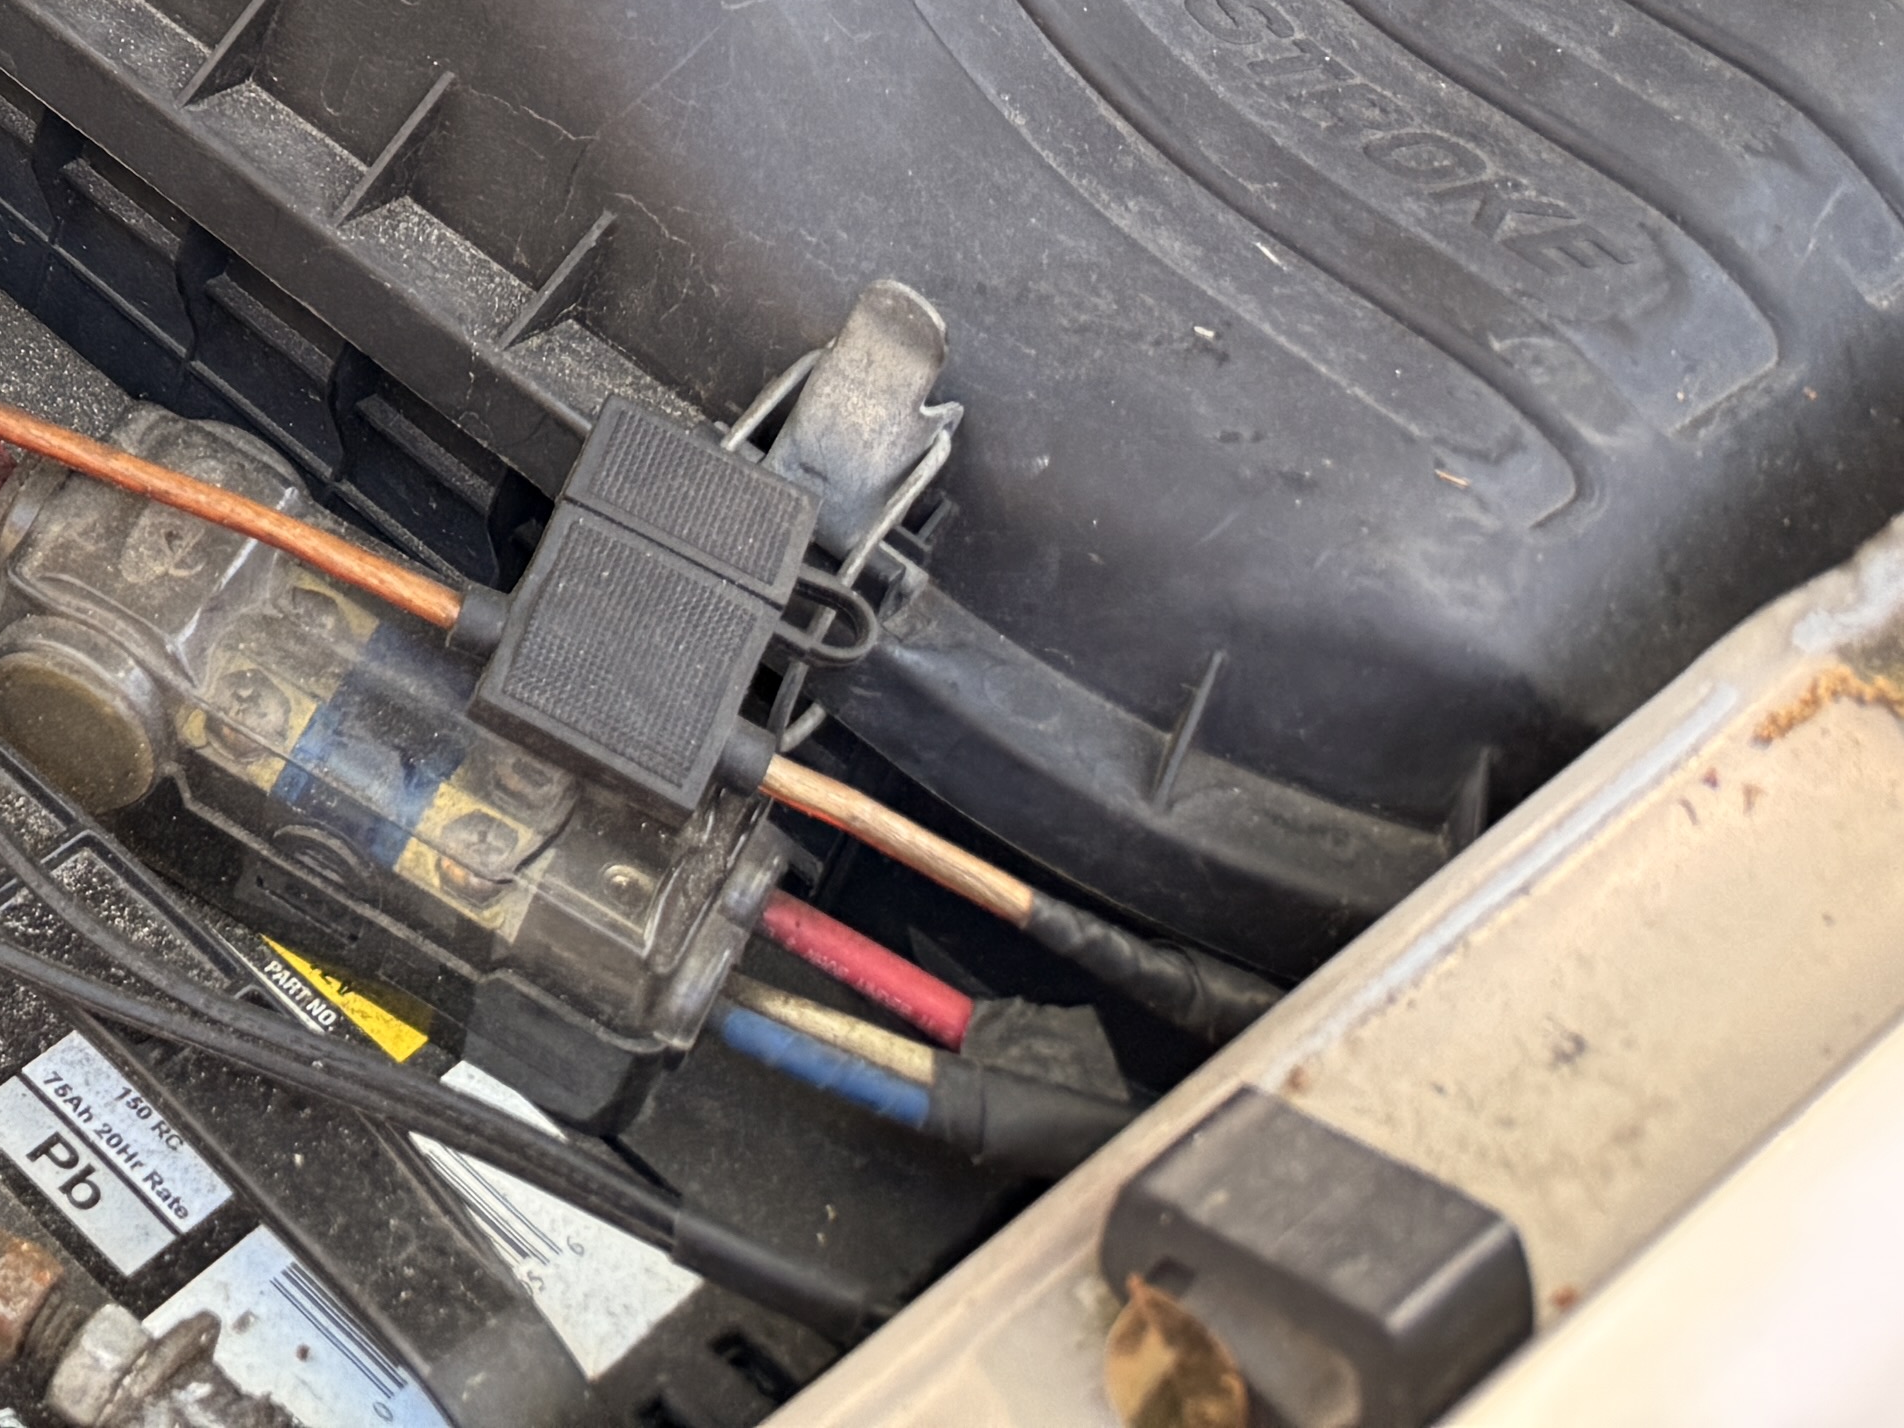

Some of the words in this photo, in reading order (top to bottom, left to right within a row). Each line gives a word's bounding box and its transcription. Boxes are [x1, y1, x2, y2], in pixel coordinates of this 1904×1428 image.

[264, 959, 306, 1008] PART
[305, 997, 339, 1033] NO.
[41, 1070, 96, 1125] 75Ah
[94, 1118, 146, 1170] 20Hr
[137, 1172, 190, 1220] Rate
[117, 1084, 154, 1123] 150
[147, 1120, 186, 1153] RC
[26, 1132, 104, 1212] Pb
